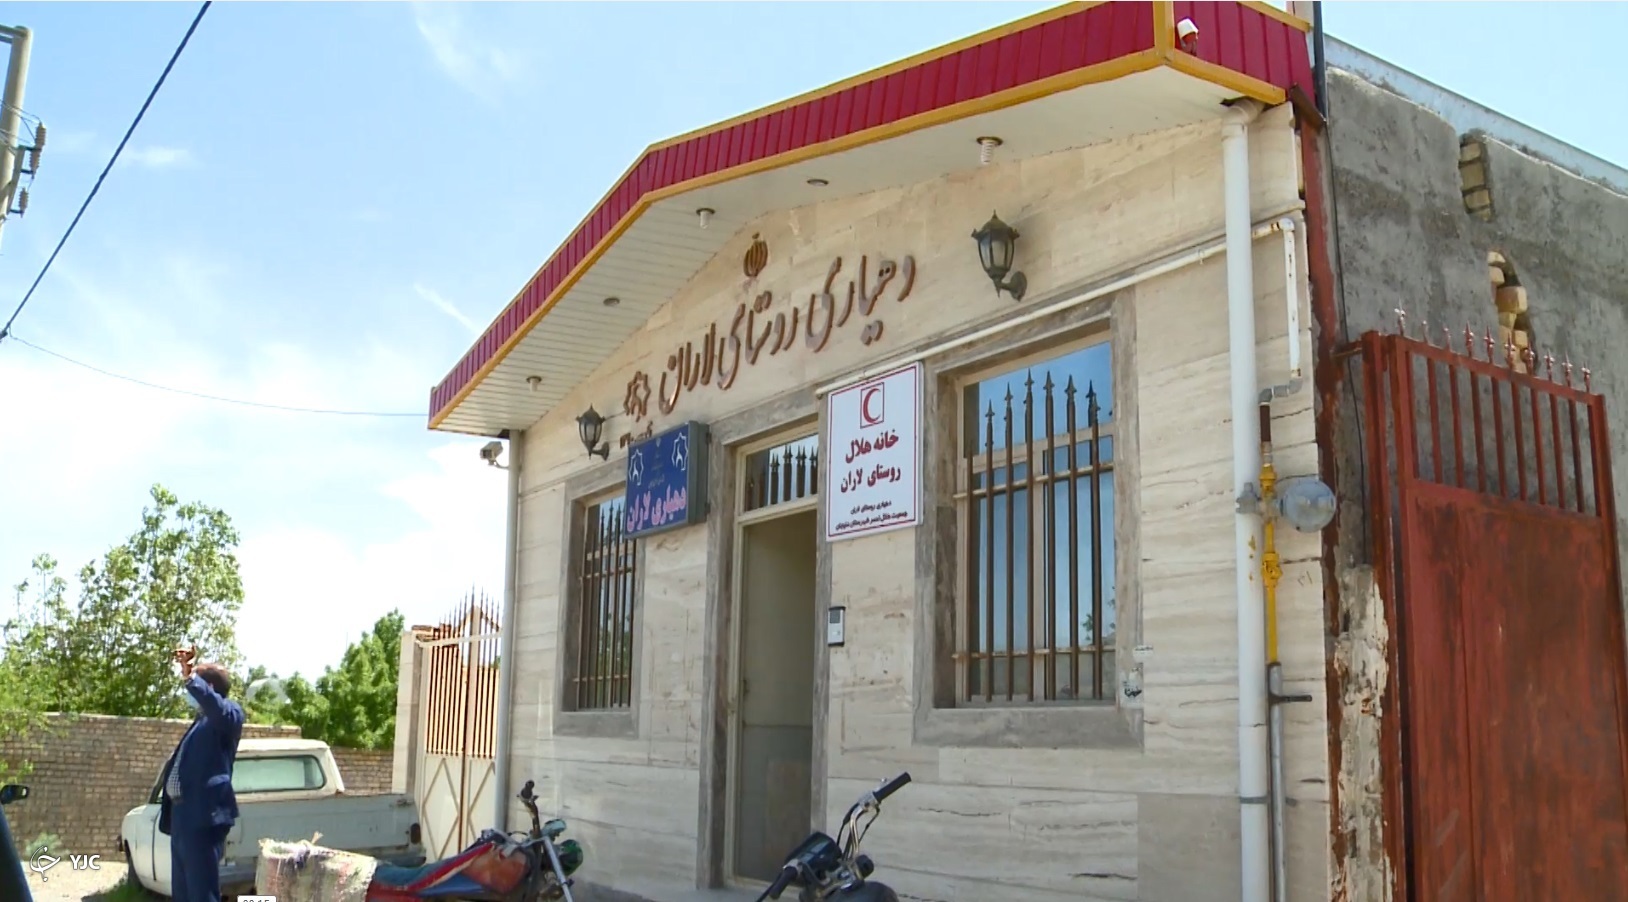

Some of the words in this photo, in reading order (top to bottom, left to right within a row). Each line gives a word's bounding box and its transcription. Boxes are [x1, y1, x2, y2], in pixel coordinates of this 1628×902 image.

[805, 255, 916, 353] دهیاری
[717, 290, 799, 390] روستای
[845, 437, 872, 464] هلال
[873, 429, 899, 450] خانه
[840, 468, 863, 493] لاران
[867, 463, 901, 487] روستای
[626, 491, 651, 533] لاران
[651, 484, 687, 525] دهیاری
